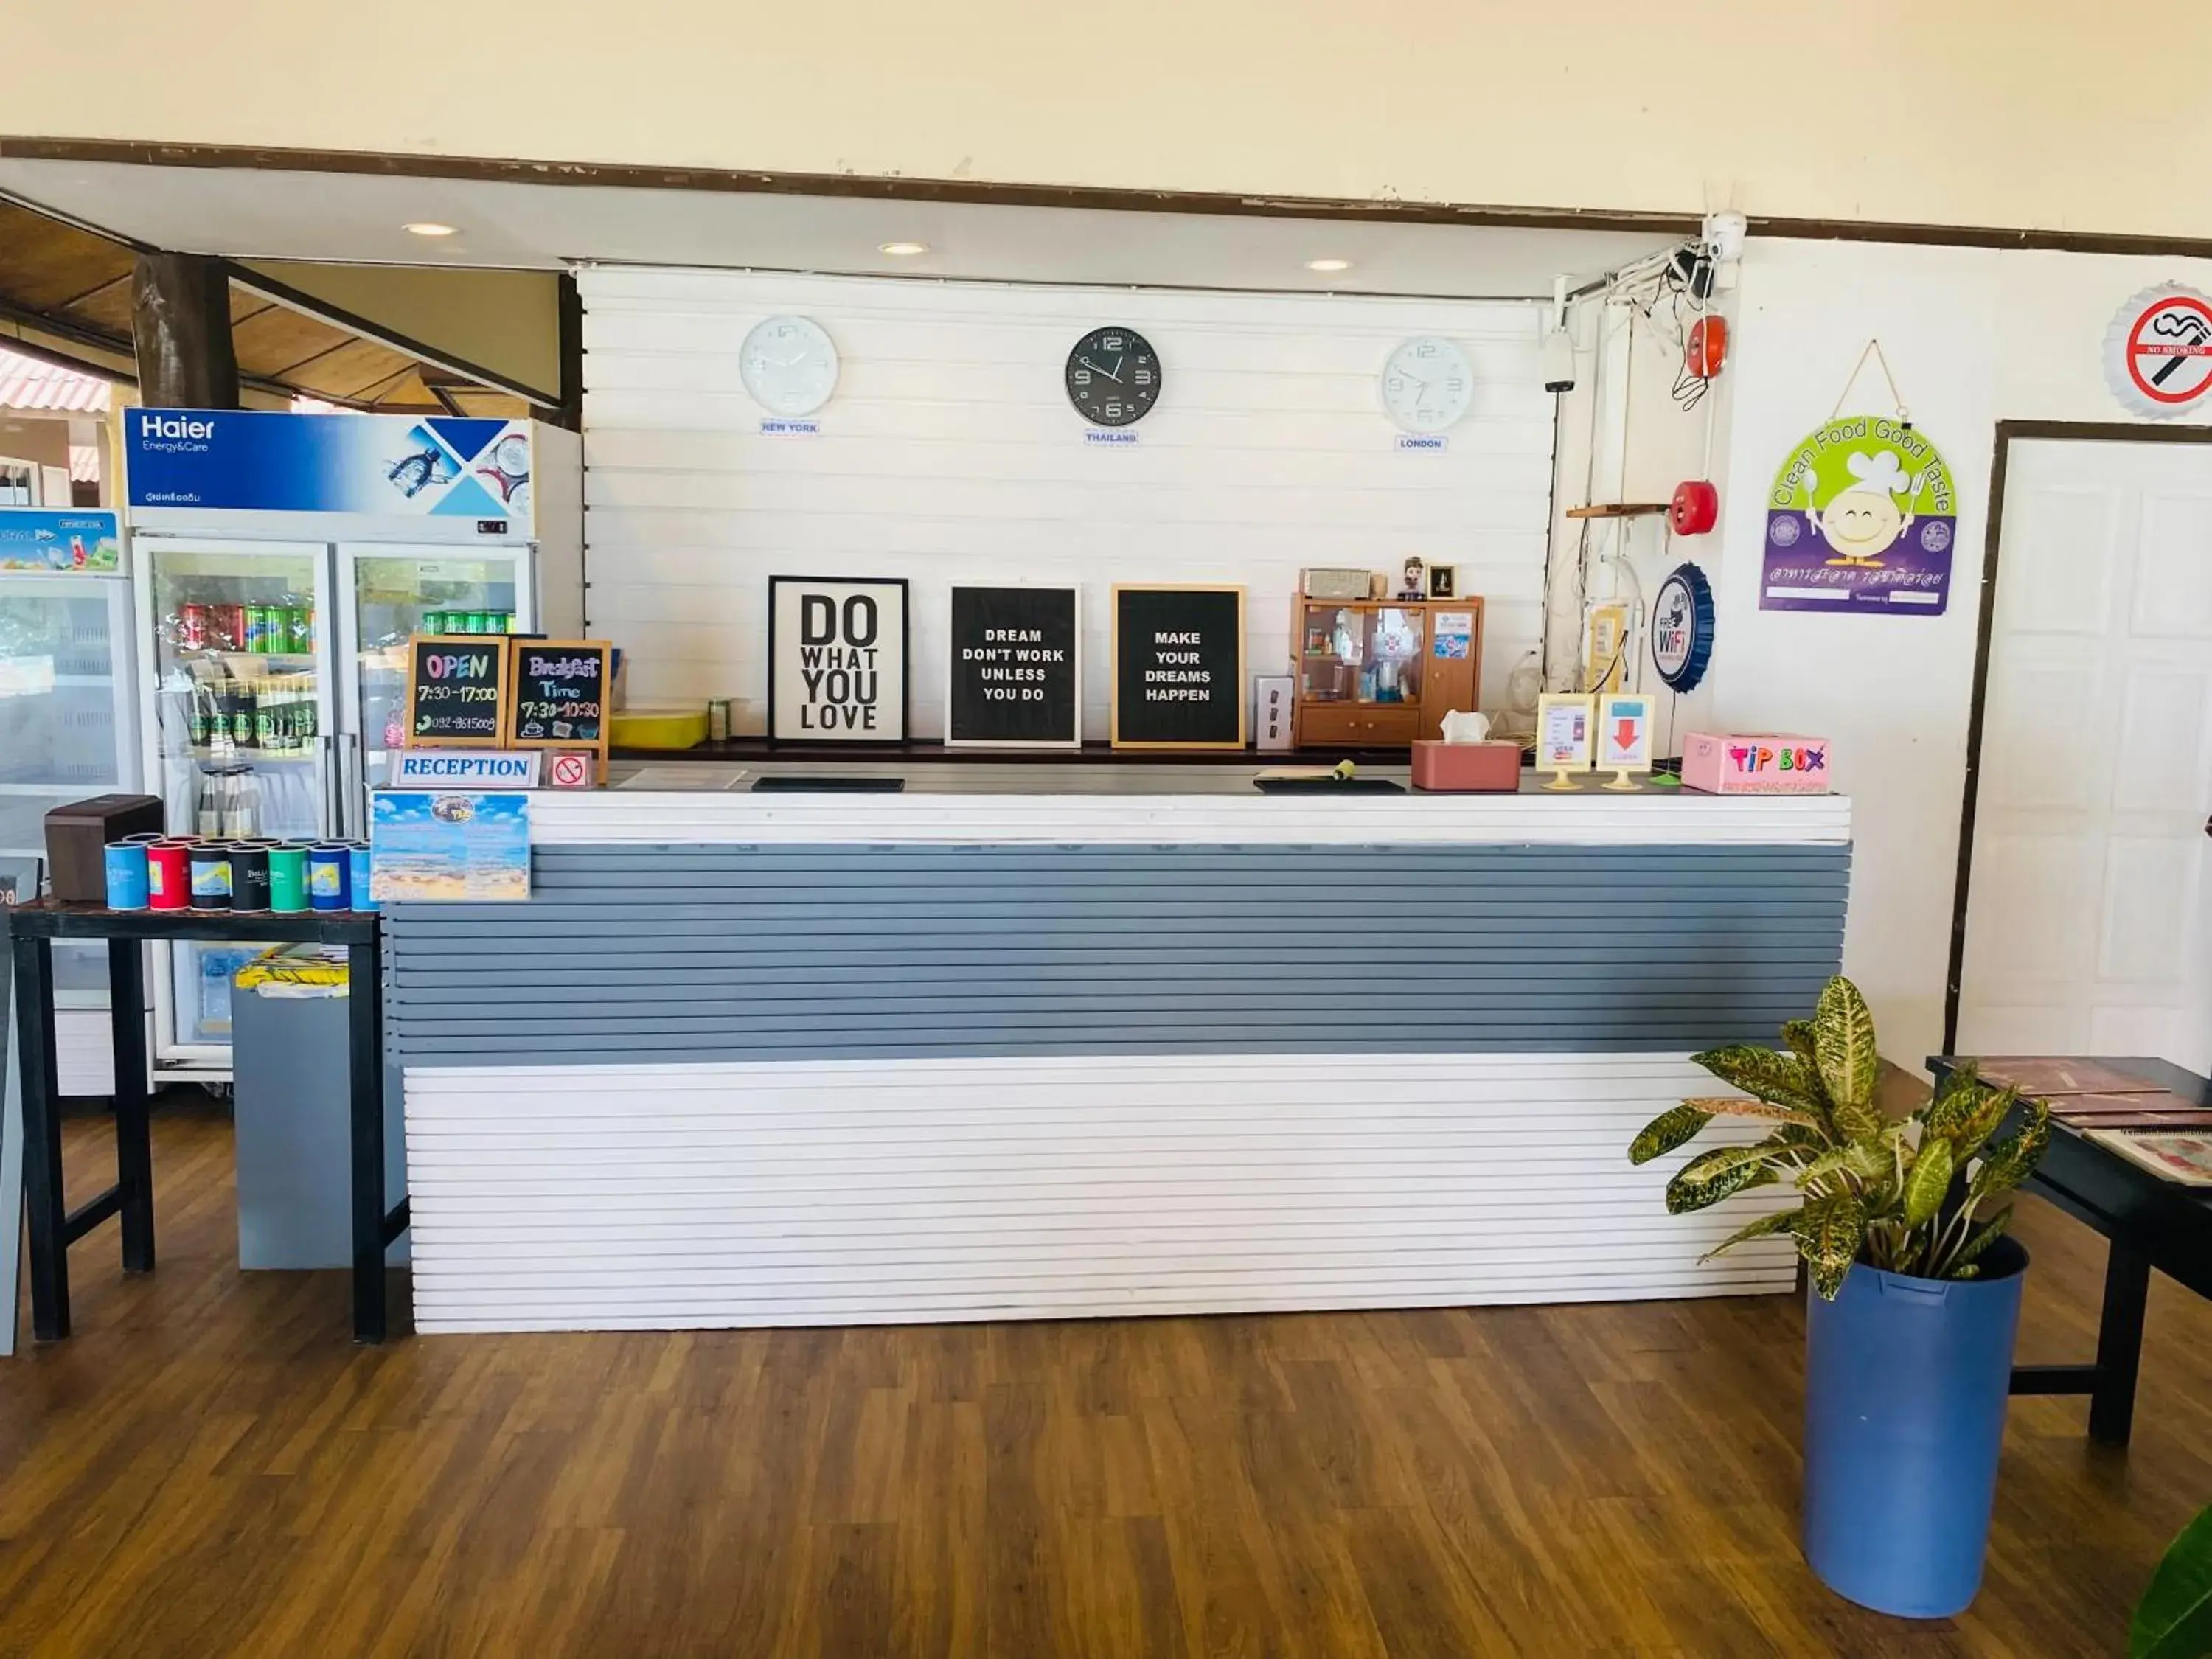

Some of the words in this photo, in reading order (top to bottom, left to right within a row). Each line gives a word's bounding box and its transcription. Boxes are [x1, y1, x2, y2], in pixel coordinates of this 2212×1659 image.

[1102, 337, 1122, 351] 12
[2146, 346, 2161, 354] NO
[2163, 347, 2205, 355] SMOKING
[1074, 370, 1091, 384] 9
[1135, 370, 1151, 384] 3
[1105, 403, 1121, 417] 6
[141, 415, 215, 439] Haier
[761, 423, 785, 432] NEW
[789, 424, 818, 433] YORK
[1085, 433, 1137, 442] THAILAND
[1400, 439, 1441, 448] LONDON
[142, 441, 209, 453] Energy&Care
[1773, 448, 1816, 506] Clean
[1813, 419, 1867, 451] Food
[1875, 420, 1929, 459] Good
[1922, 453, 1950, 512] Taste
[801, 594, 877, 647] DO
[1660, 617, 1676, 628] FREE
[985, 629, 1042, 641] DREAM
[1155, 632, 1201, 644] MAKE
[1660, 630, 1685, 653] WiFi
[801, 647, 878, 669] WHAT
[962, 648, 1012, 660] DON'T
[1016, 650, 1064, 661] WORK
[1155, 652, 1200, 664] YOUR
[426, 655, 489, 678] OPEN
[981, 668, 1046, 681] UNLESS
[1145, 670, 1211, 683] DREAMS
[538, 680, 580, 698] Time
[801, 669, 877, 704] YOU
[984, 688, 1017, 700] YOU
[1022, 689, 1043, 700] DO
[1146, 689, 1210, 701] HAPPEN
[801, 704, 877, 729] LOVE
[403, 757, 529, 776] RECEPTION
[1779, 748, 1825, 772] BOX
